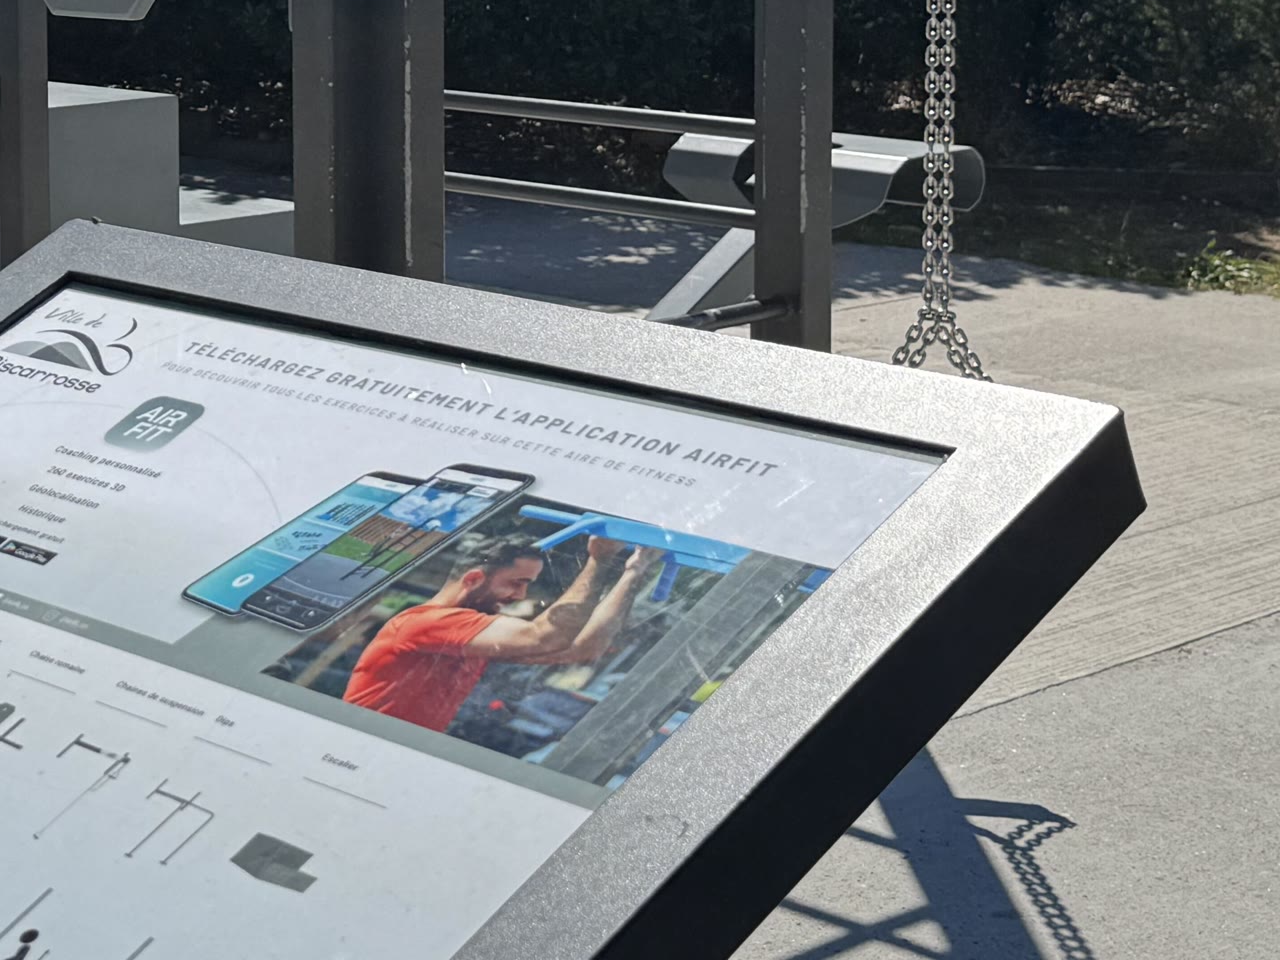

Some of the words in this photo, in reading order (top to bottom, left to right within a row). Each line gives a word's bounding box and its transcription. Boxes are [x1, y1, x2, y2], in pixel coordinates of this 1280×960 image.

[44, 307, 84, 324] Ville
[84, 313, 107, 328] de
[136, 406, 188, 427] AIR
[184, 341, 325, 380] TÉLÉCHARGEZ
[325, 371, 494, 415] GRATUITEMENT
[493, 406, 681, 457] L'APPLICATION
[683, 448, 778, 478] AIRFIT
[123, 421, 173, 442] FIT
[160, 361, 193, 374] POUR
[192, 368, 261, 390] DÉCOUVRIR
[261, 383, 297, 398] TOUS
[295, 391, 322, 404] LES
[322, 396, 397, 420] EXERCICES
[410, 416, 479, 438] RÉALISER
[480, 432, 511, 444] SUR
[512, 438, 560, 457] CETTE
[563, 450, 601, 465] AIRE
[603, 459, 623, 471] DE
[628, 464, 697, 488] FITNESS
[54, 445, 99, 464] Coaching
[98, 456, 163, 479] personnalisé
[46, 465, 67, 476] 260
[65, 471, 111, 488] exercices
[109, 482, 126, 492] 3D
[29, 483, 100, 509] Géolocalisation
[18, 504, 67, 523] Historique
[147, 692, 159, 700] de
[321, 752, 359, 771] Escalier
